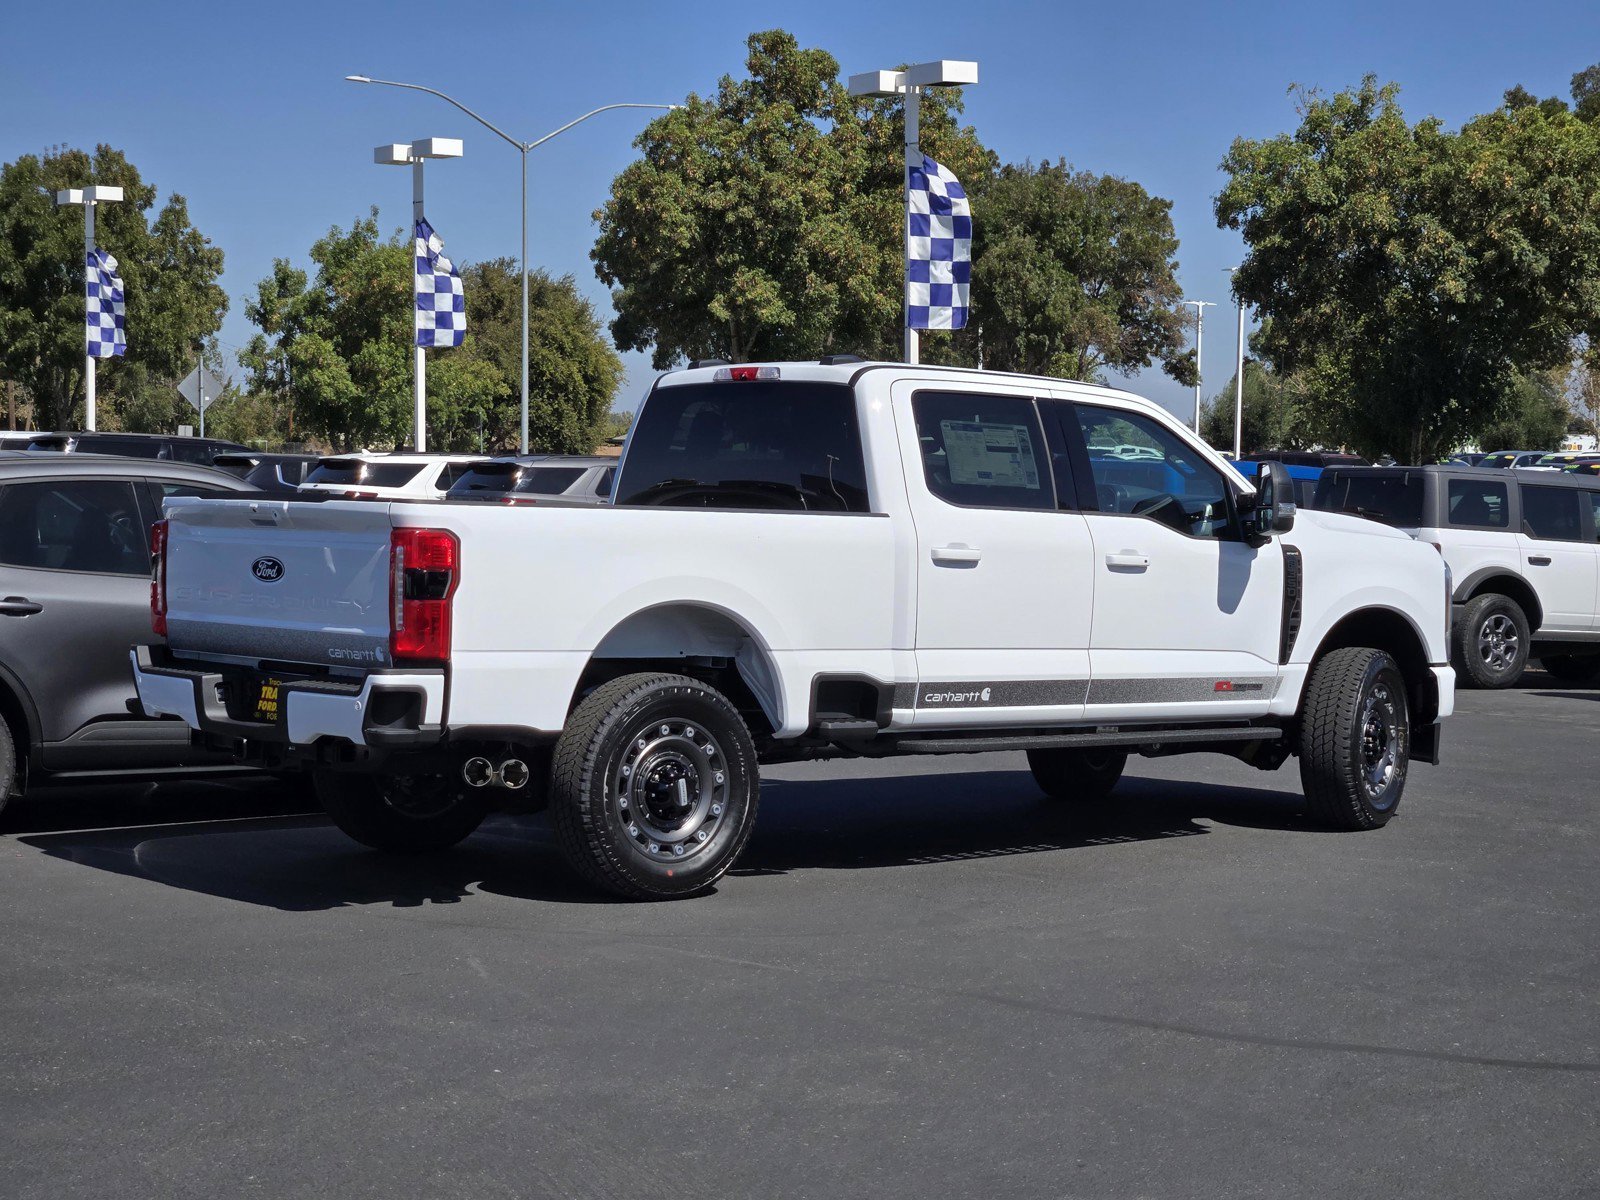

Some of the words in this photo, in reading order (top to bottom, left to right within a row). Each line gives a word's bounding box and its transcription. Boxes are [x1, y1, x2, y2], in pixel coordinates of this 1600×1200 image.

[255, 559, 279, 579] Ford
[328, 648, 375, 661] carhartt
[261, 686, 278, 700] TRA
[925, 691, 980, 702] carhartt
